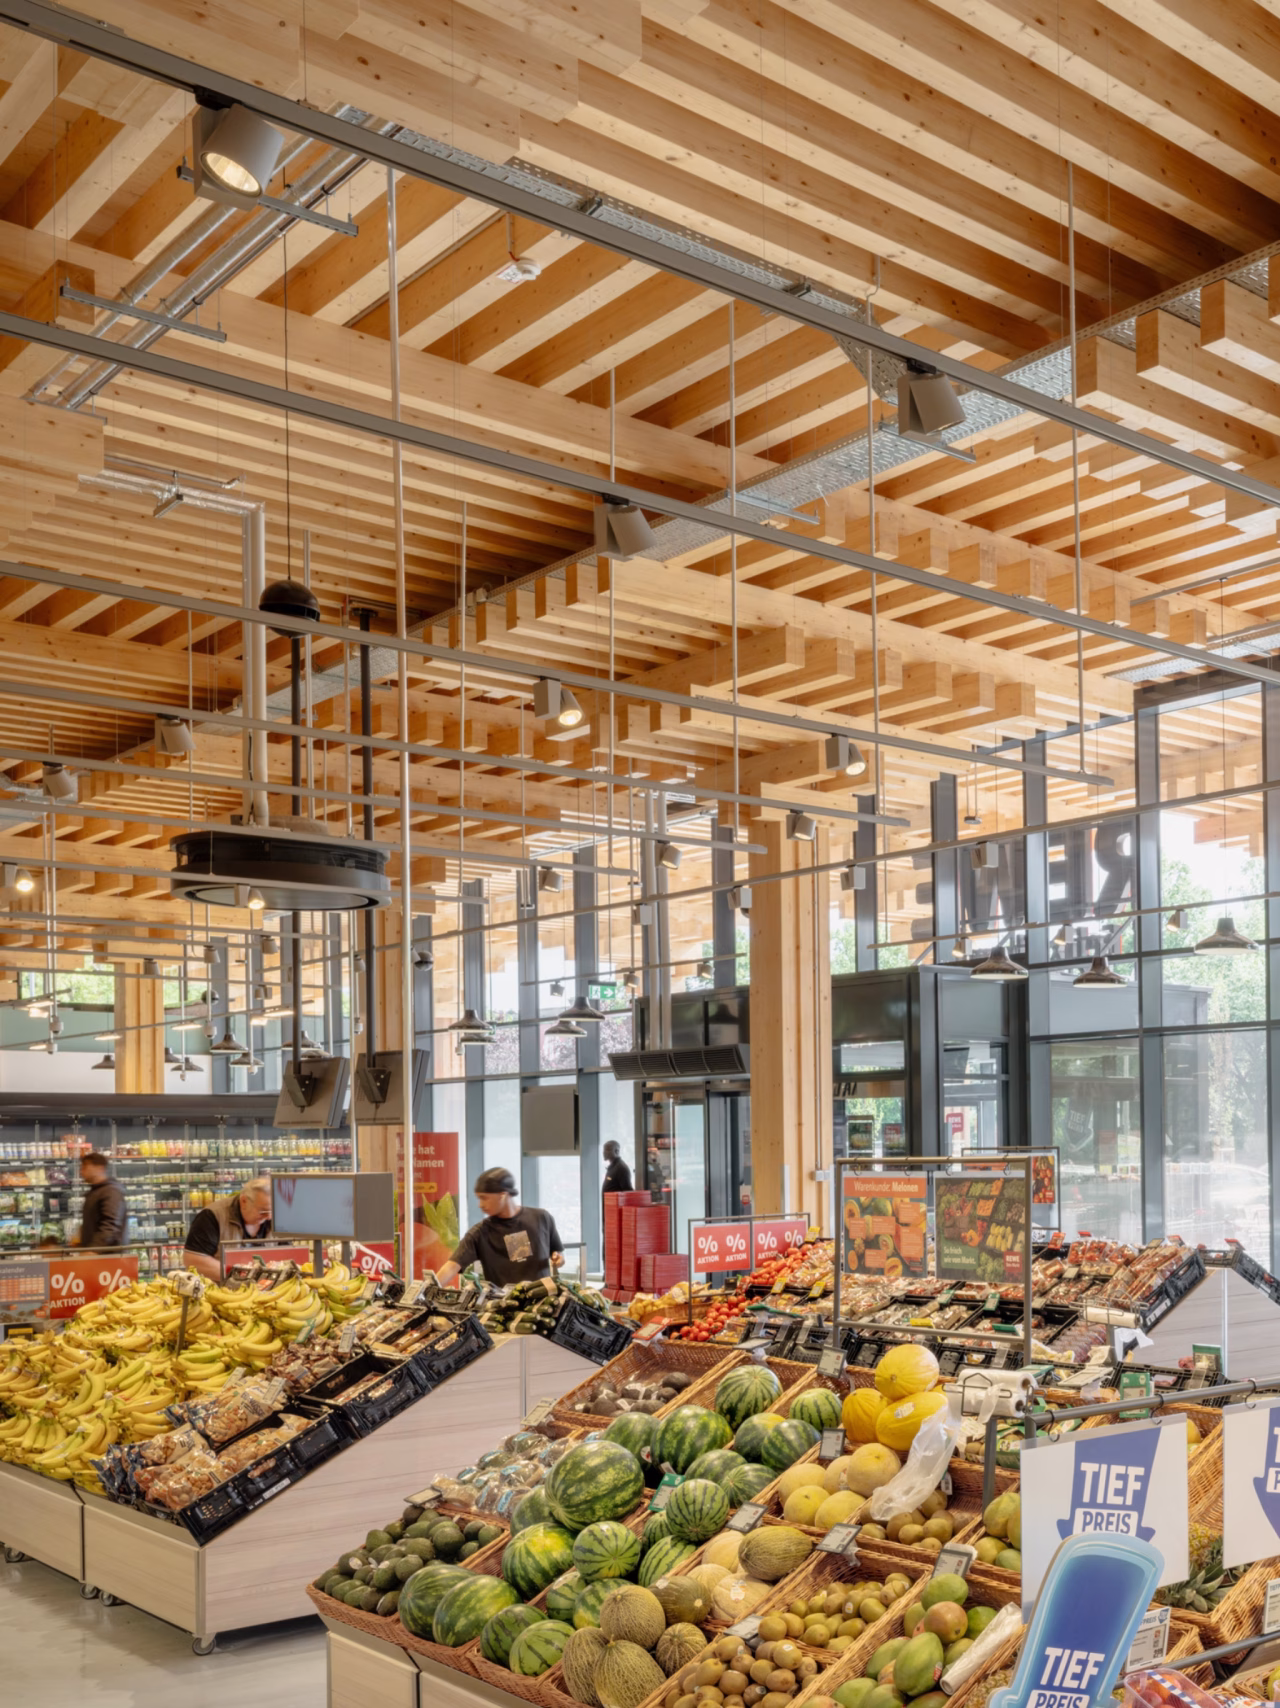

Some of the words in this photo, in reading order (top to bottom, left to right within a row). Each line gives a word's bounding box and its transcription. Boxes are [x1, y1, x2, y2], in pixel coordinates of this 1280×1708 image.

[418, 1145, 435, 1154] hat
[854, 1181, 890, 1192] Warenkunde:
[891, 1182, 919, 1192] Melonen
[698, 1255, 719, 1264] AKTION
[725, 1252, 747, 1262] AKTION
[50, 1296, 86, 1309] AKTION
[1080, 1461, 1145, 1506] TIEF
[1082, 1510, 1132, 1534] PREIS
[1040, 1647, 1105, 1690] TIEF
[1035, 1692, 1083, 1708] PREIS
